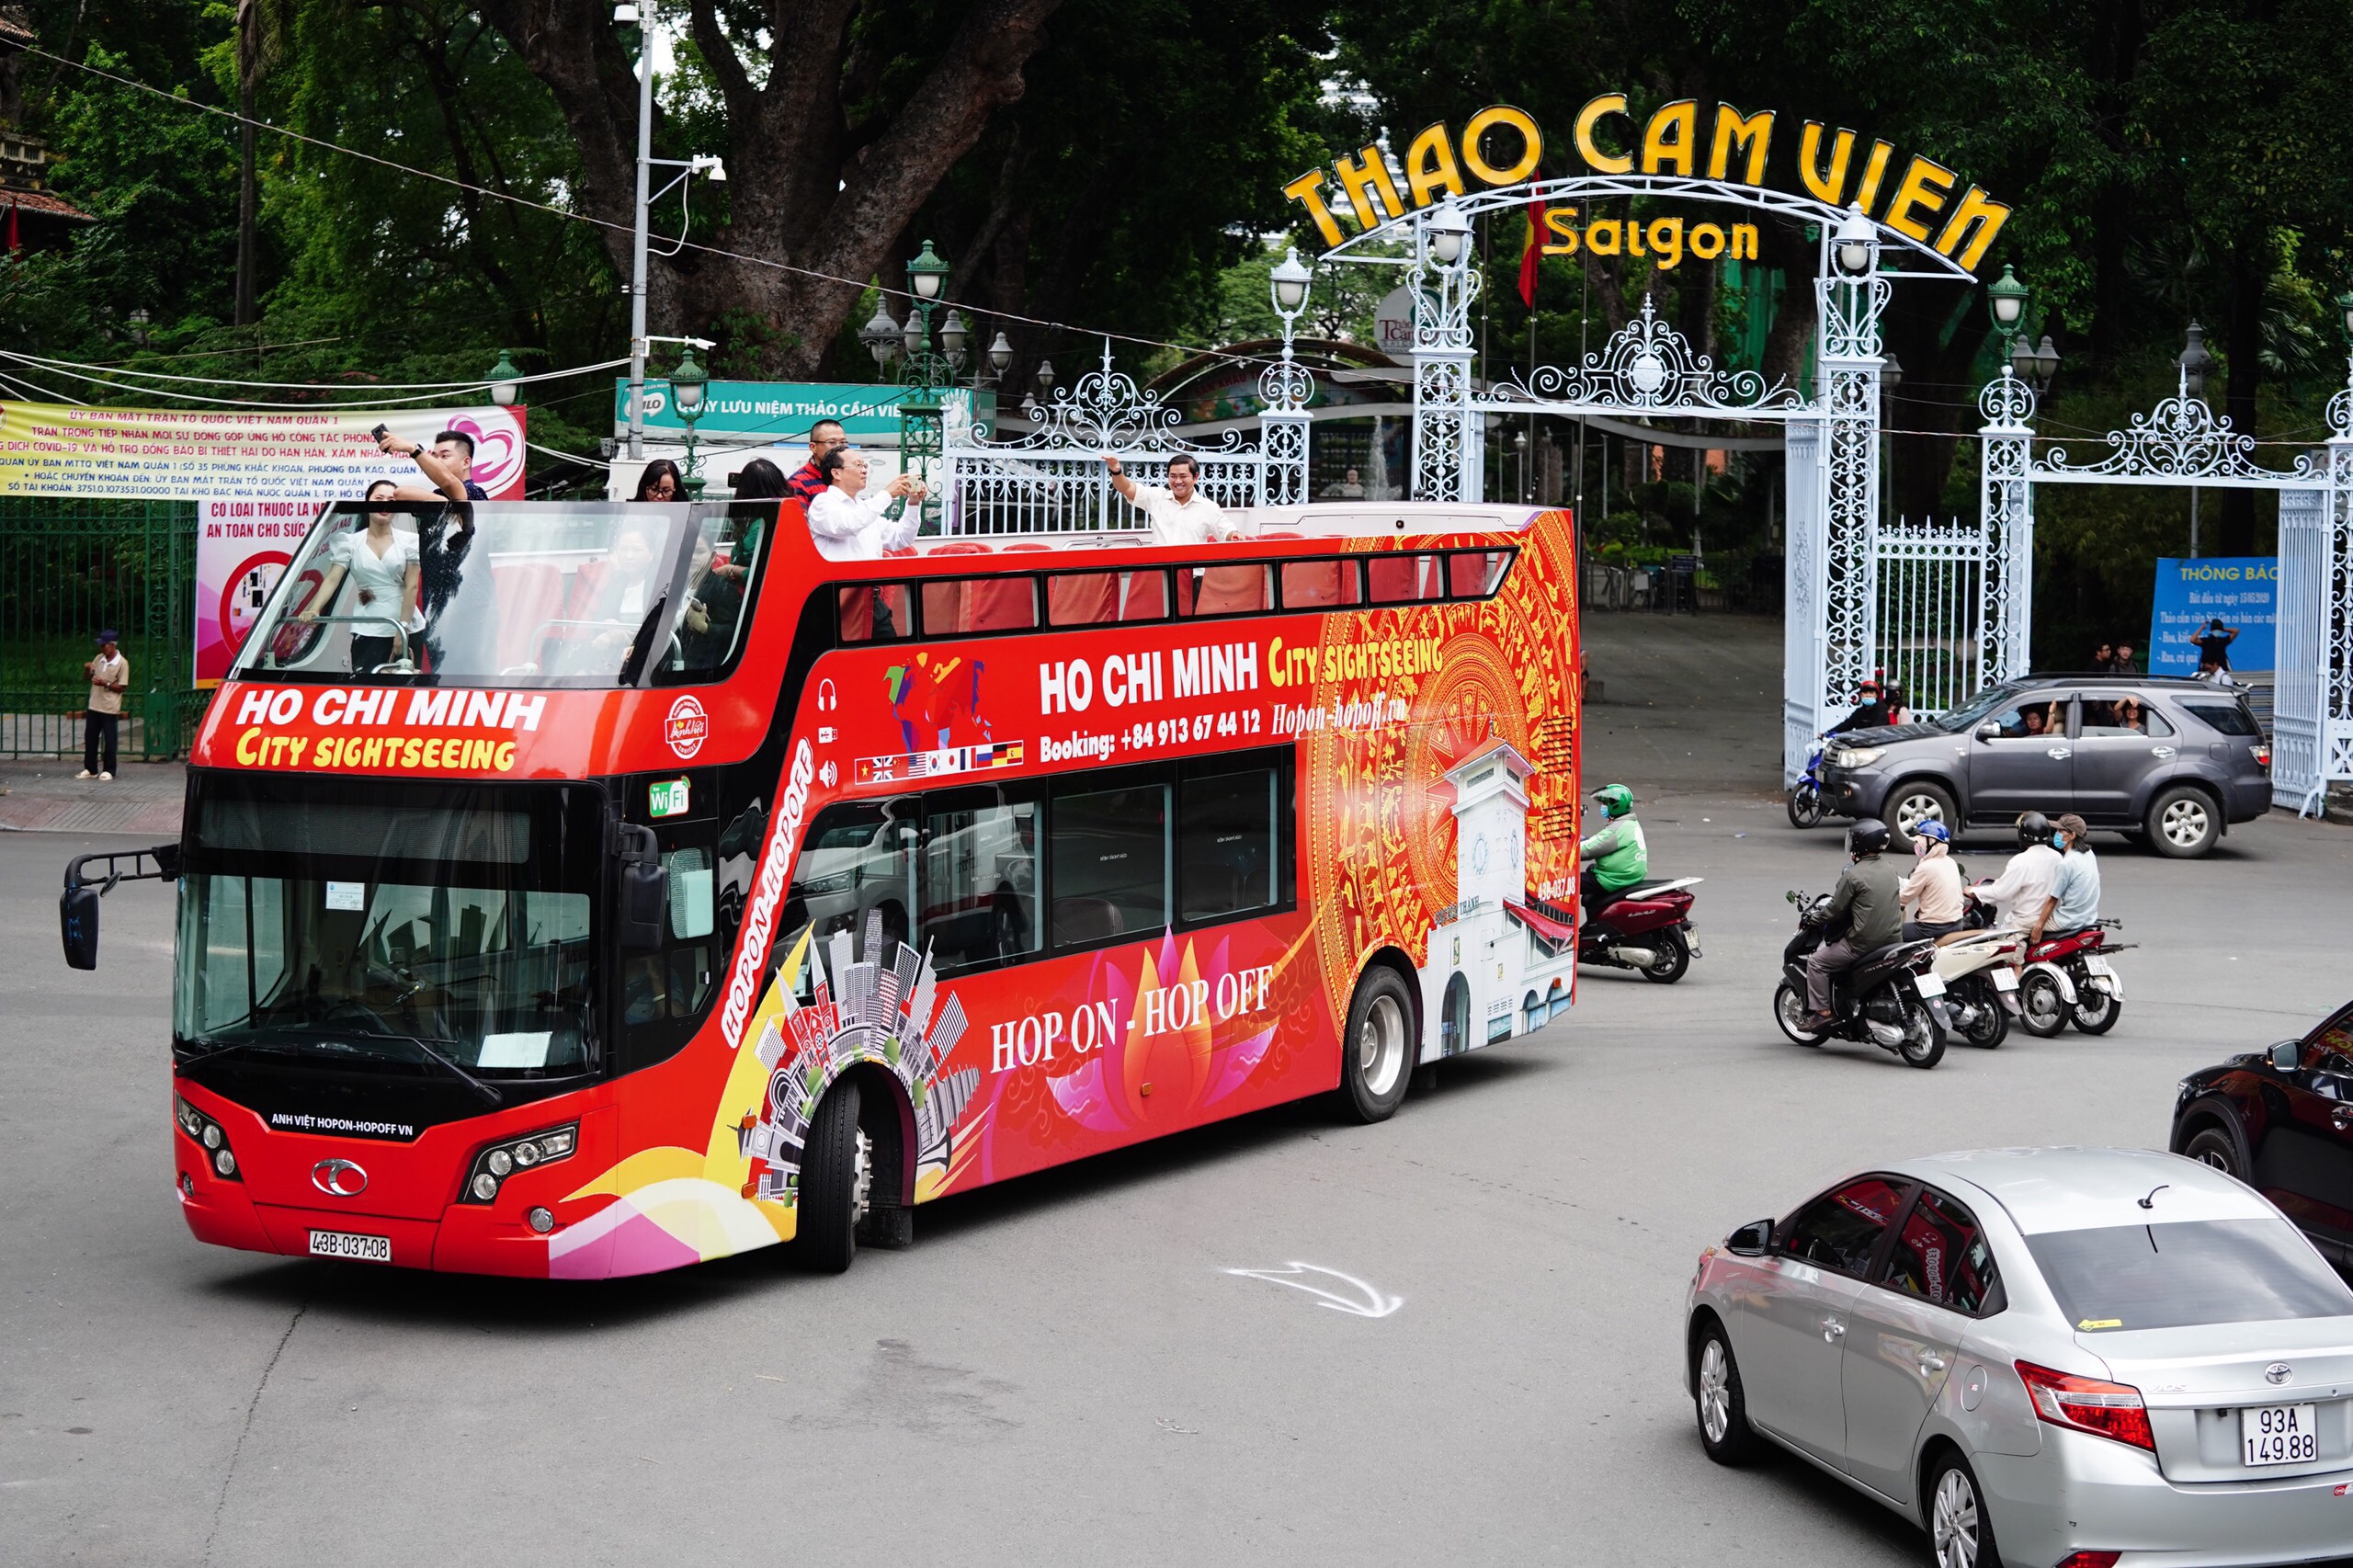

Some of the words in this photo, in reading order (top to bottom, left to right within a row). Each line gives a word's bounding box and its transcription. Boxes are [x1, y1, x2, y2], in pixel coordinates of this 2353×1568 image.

[1281, 103, 1545, 249] THAO
[1574, 92, 1777, 187] CAM
[1540, 205, 1759, 272] Saigon
[89, 412, 113, 421] BAN
[267, 416, 292, 425] NAM
[333, 416, 339, 426] 1
[642, 399, 661, 410] ILO
[721, 399, 752, 414] LƯU
[755, 400, 793, 418] NIỆM
[795, 400, 837, 415] THẢO
[877, 403, 902, 418] VIÊ
[33, 442, 77, 452] COVID-19
[262, 448, 276, 457] DO
[43, 459, 62, 467] BAN
[64, 460, 92, 468] MTTQ
[118, 460, 140, 469] NAM
[199, 462, 209, 471] 35
[171, 475, 189, 484] BAN
[191, 487, 210, 495] KHO
[207, 523, 222, 538] AN
[258, 523, 279, 538] CHO
[2181, 564, 2240, 581] THÔNG
[2245, 563, 2279, 581] BÁO
[1040, 657, 1094, 716] HO
[1101, 648, 1164, 708] CHI
[1171, 641, 1259, 699] MINH
[235, 687, 303, 726] HO
[311, 688, 398, 727] CHI
[405, 689, 547, 733] MINH
[1040, 732, 1116, 764] Booking:
[1120, 722, 1155, 752] +84
[1157, 716, 1189, 746] 913
[1192, 713, 1214, 742] 67
[1216, 710, 1238, 738] 44
[1242, 708, 1261, 735] 12
[722, 737, 813, 1048] HOPON-HOPOFF
[990, 1010, 1063, 1074] HOP
[1071, 997, 1119, 1054] ON
[1143, 978, 1210, 1038] HOP
[1216, 964, 1274, 1020] OFF
[271, 1113, 292, 1127] ANH
[293, 1113, 316, 1131] VIỆT
[317, 1117, 397, 1135] HOPON-HOPOFF
[398, 1124, 414, 1136] VN
[2260, 1408, 2299, 1435] 93A
[2247, 1434, 2314, 1464] 149.88
